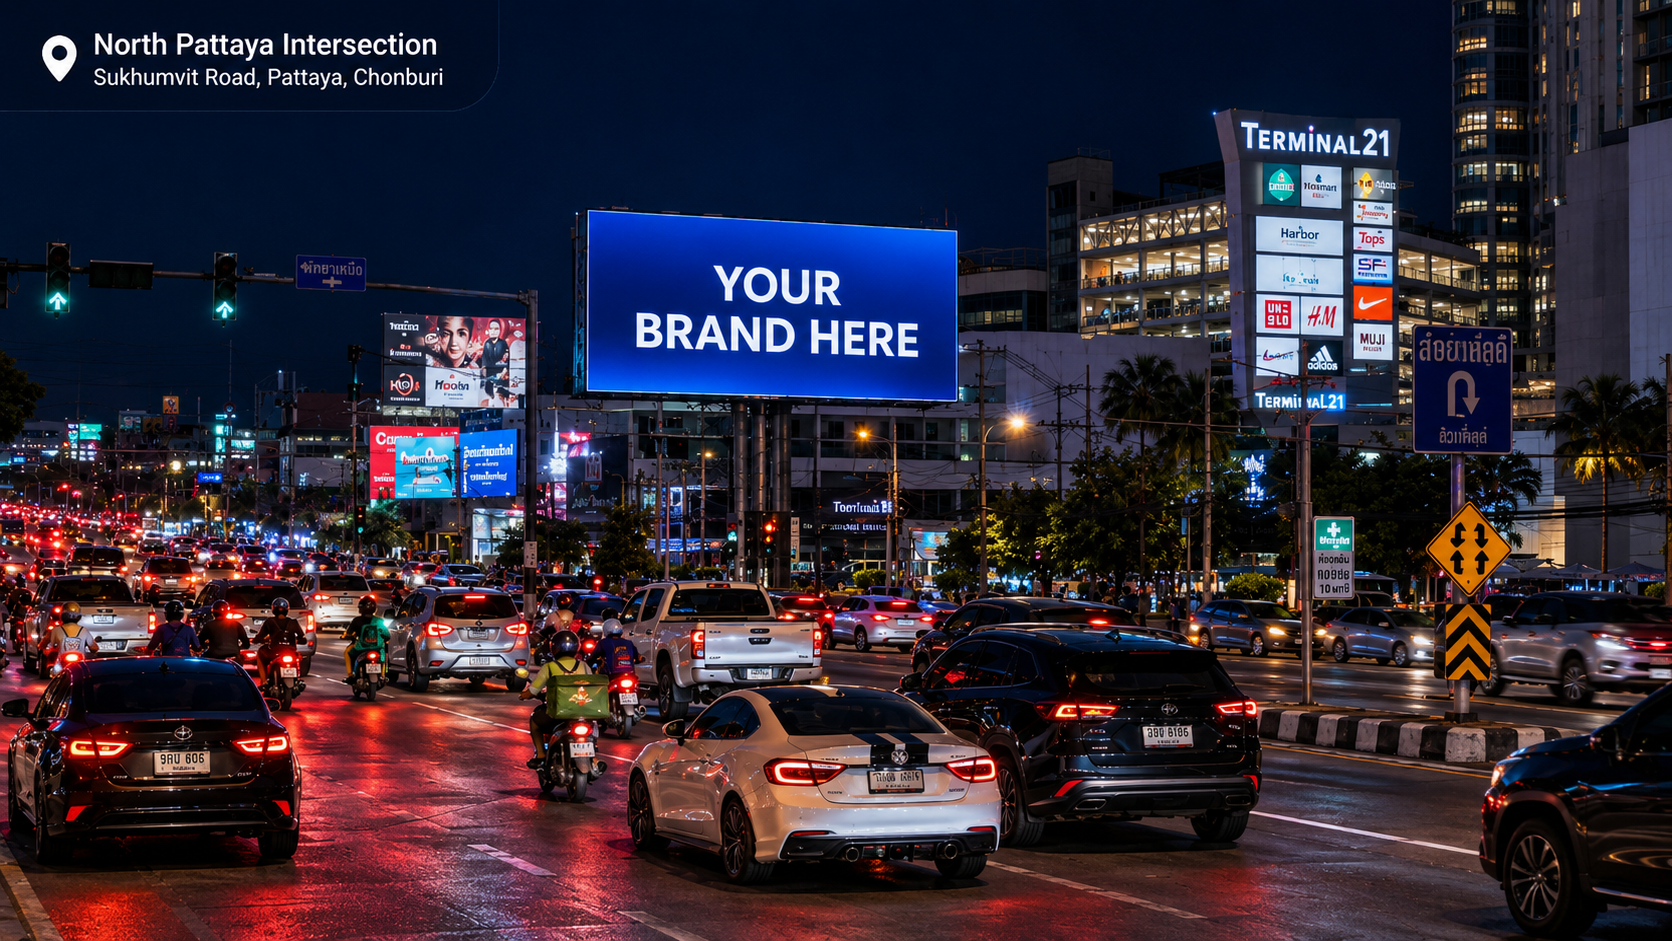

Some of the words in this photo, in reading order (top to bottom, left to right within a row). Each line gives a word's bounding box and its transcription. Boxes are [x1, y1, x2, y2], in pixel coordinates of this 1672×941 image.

[1281, 227, 1320, 240] Harbor
[1358, 231, 1385, 248] Tops
[713, 265, 842, 306] YOUR
[636, 312, 796, 353] BRAND
[810, 318, 919, 358] HERE
[1360, 332, 1385, 345] MUJI
[185, 752, 205, 764] 606
